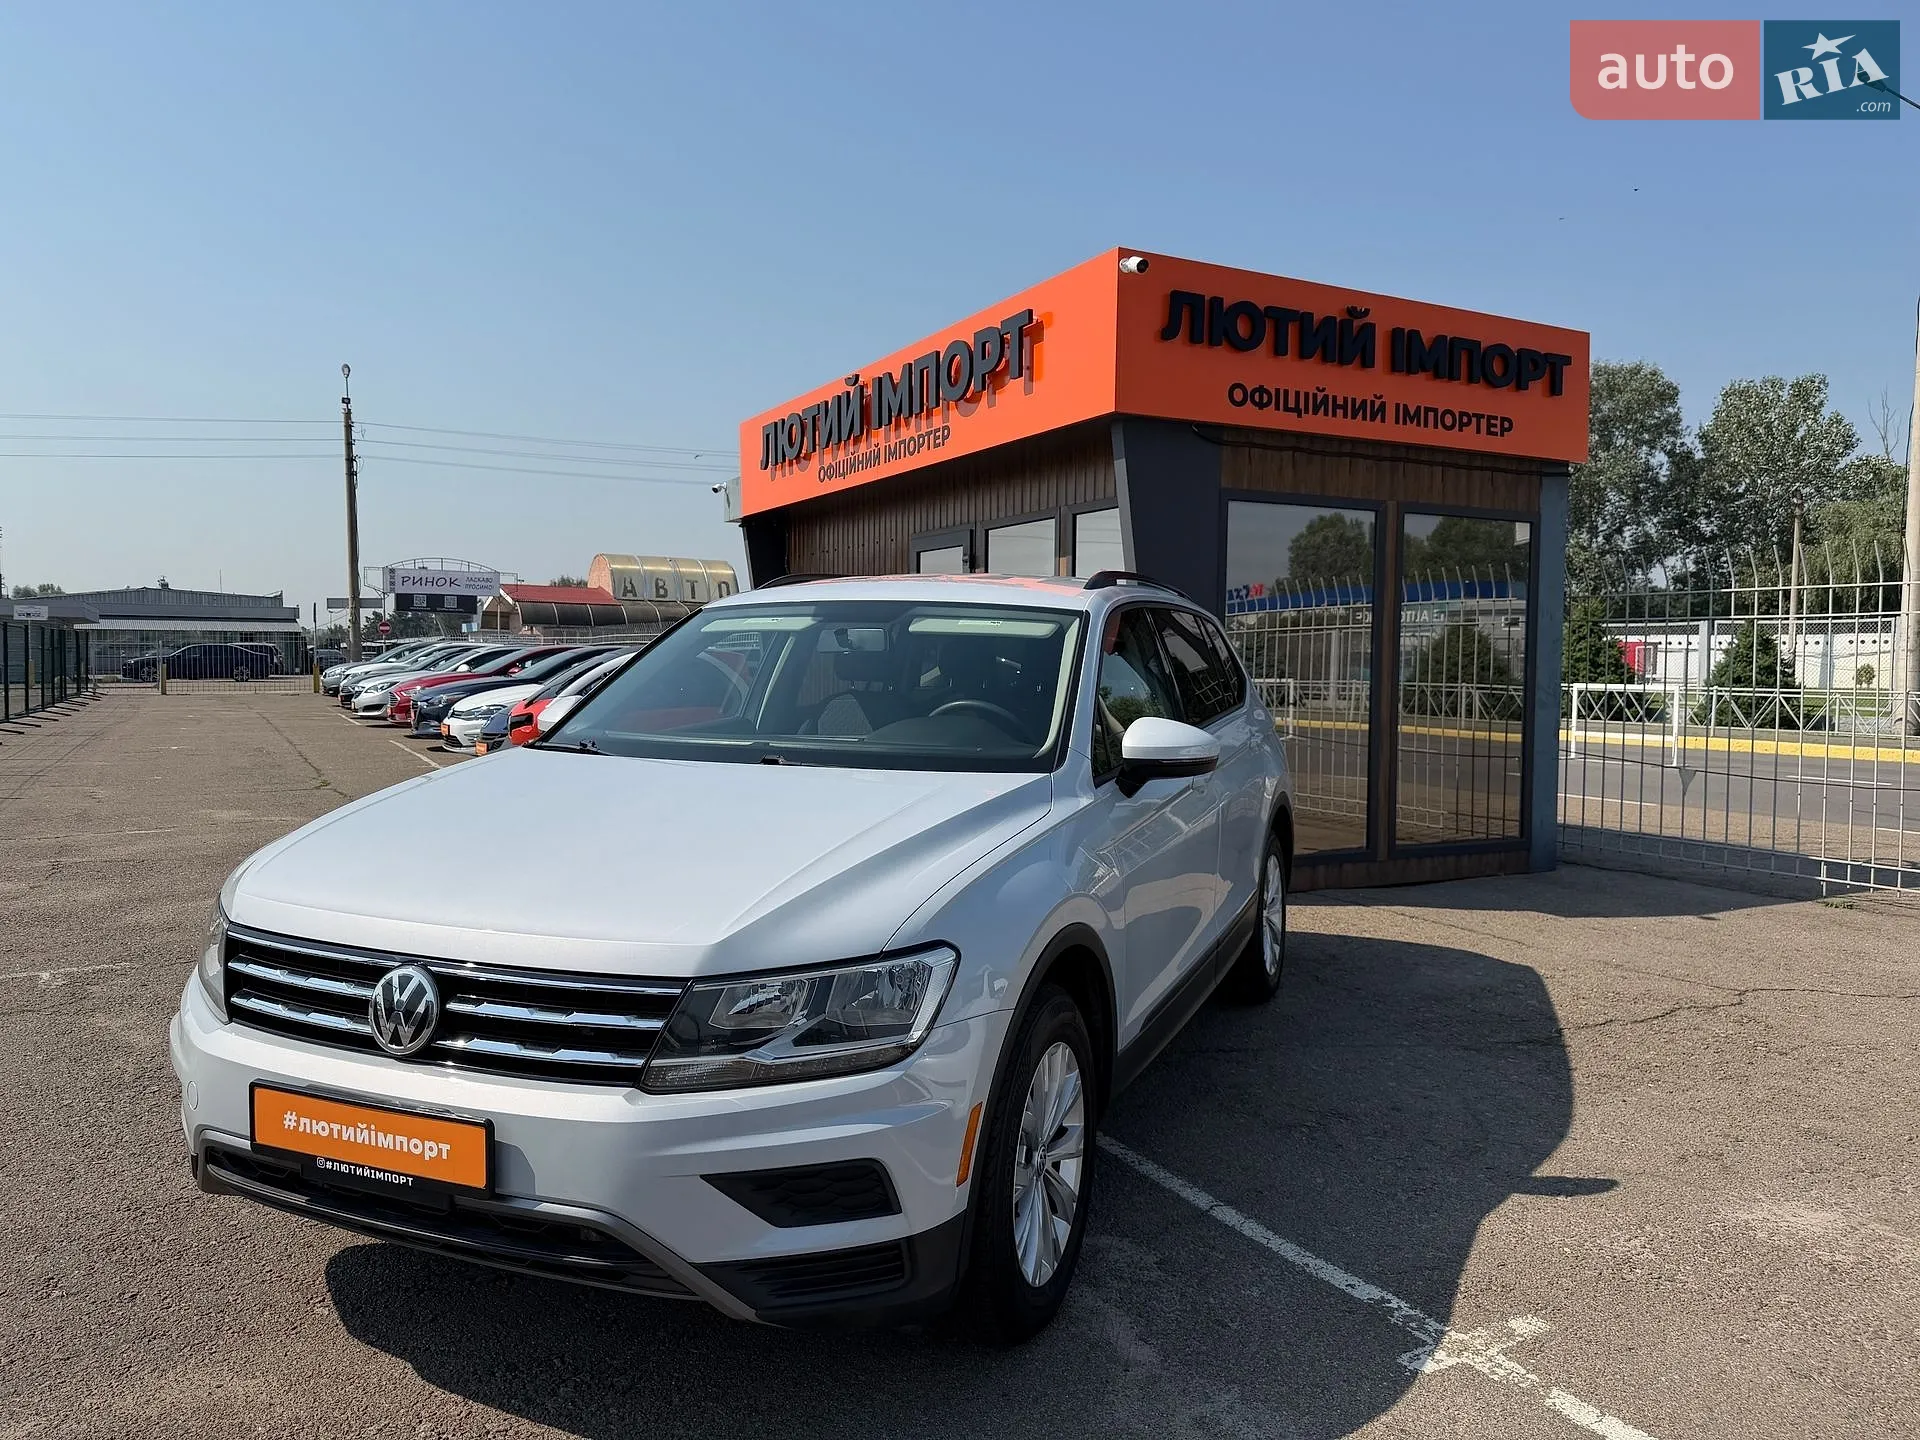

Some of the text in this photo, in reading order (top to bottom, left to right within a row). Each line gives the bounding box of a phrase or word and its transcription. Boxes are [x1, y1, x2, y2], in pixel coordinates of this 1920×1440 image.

[1161, 289, 1572, 397] ЛЮТИЙ ІМПОРТ
[760, 309, 1034, 471] ЛЮТИЙ ІМПОРТ
[1228, 382, 1514, 437] ОФІЦІЙНИЙ ІМПОРТЕР
[818, 425, 951, 484] ОФІЦІЙНИЙ ІМПОРТЕР
[400, 575, 461, 588] РИНОК
[283, 1110, 452, 1161] #лютийімпорт
